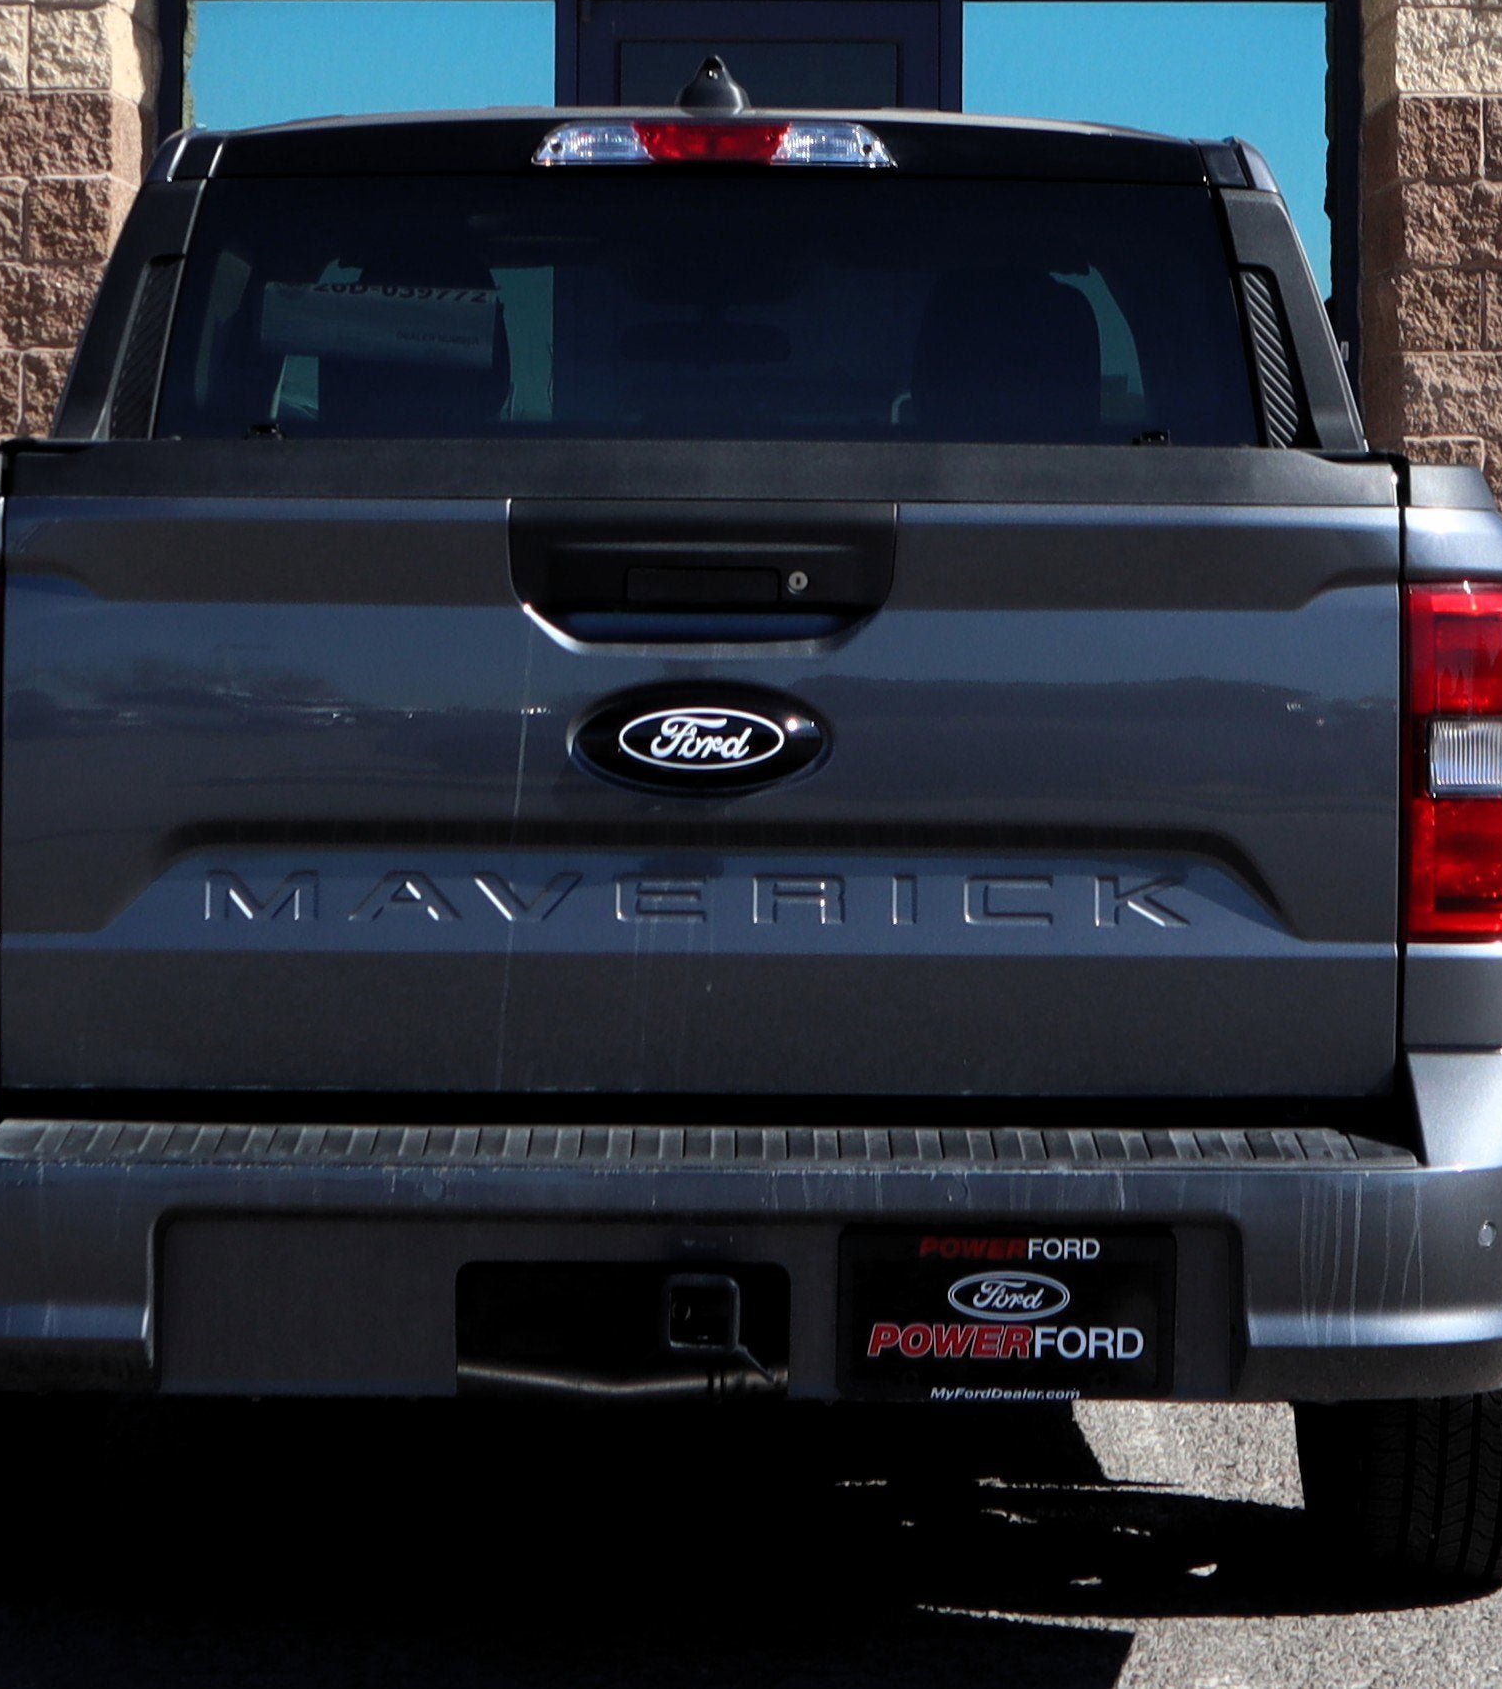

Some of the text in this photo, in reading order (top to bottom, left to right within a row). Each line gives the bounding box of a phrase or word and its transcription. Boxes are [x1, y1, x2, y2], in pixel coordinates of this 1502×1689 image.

[648, 714, 749, 762] Ford
[203, 868, 1191, 928] MAVERICK
[919, 1237, 1100, 1261] POWERFORD
[973, 1279, 1044, 1310] Ford
[867, 1322, 1145, 1360] POWERFORD
[930, 1386, 1081, 1401] MyFordDealer.com
